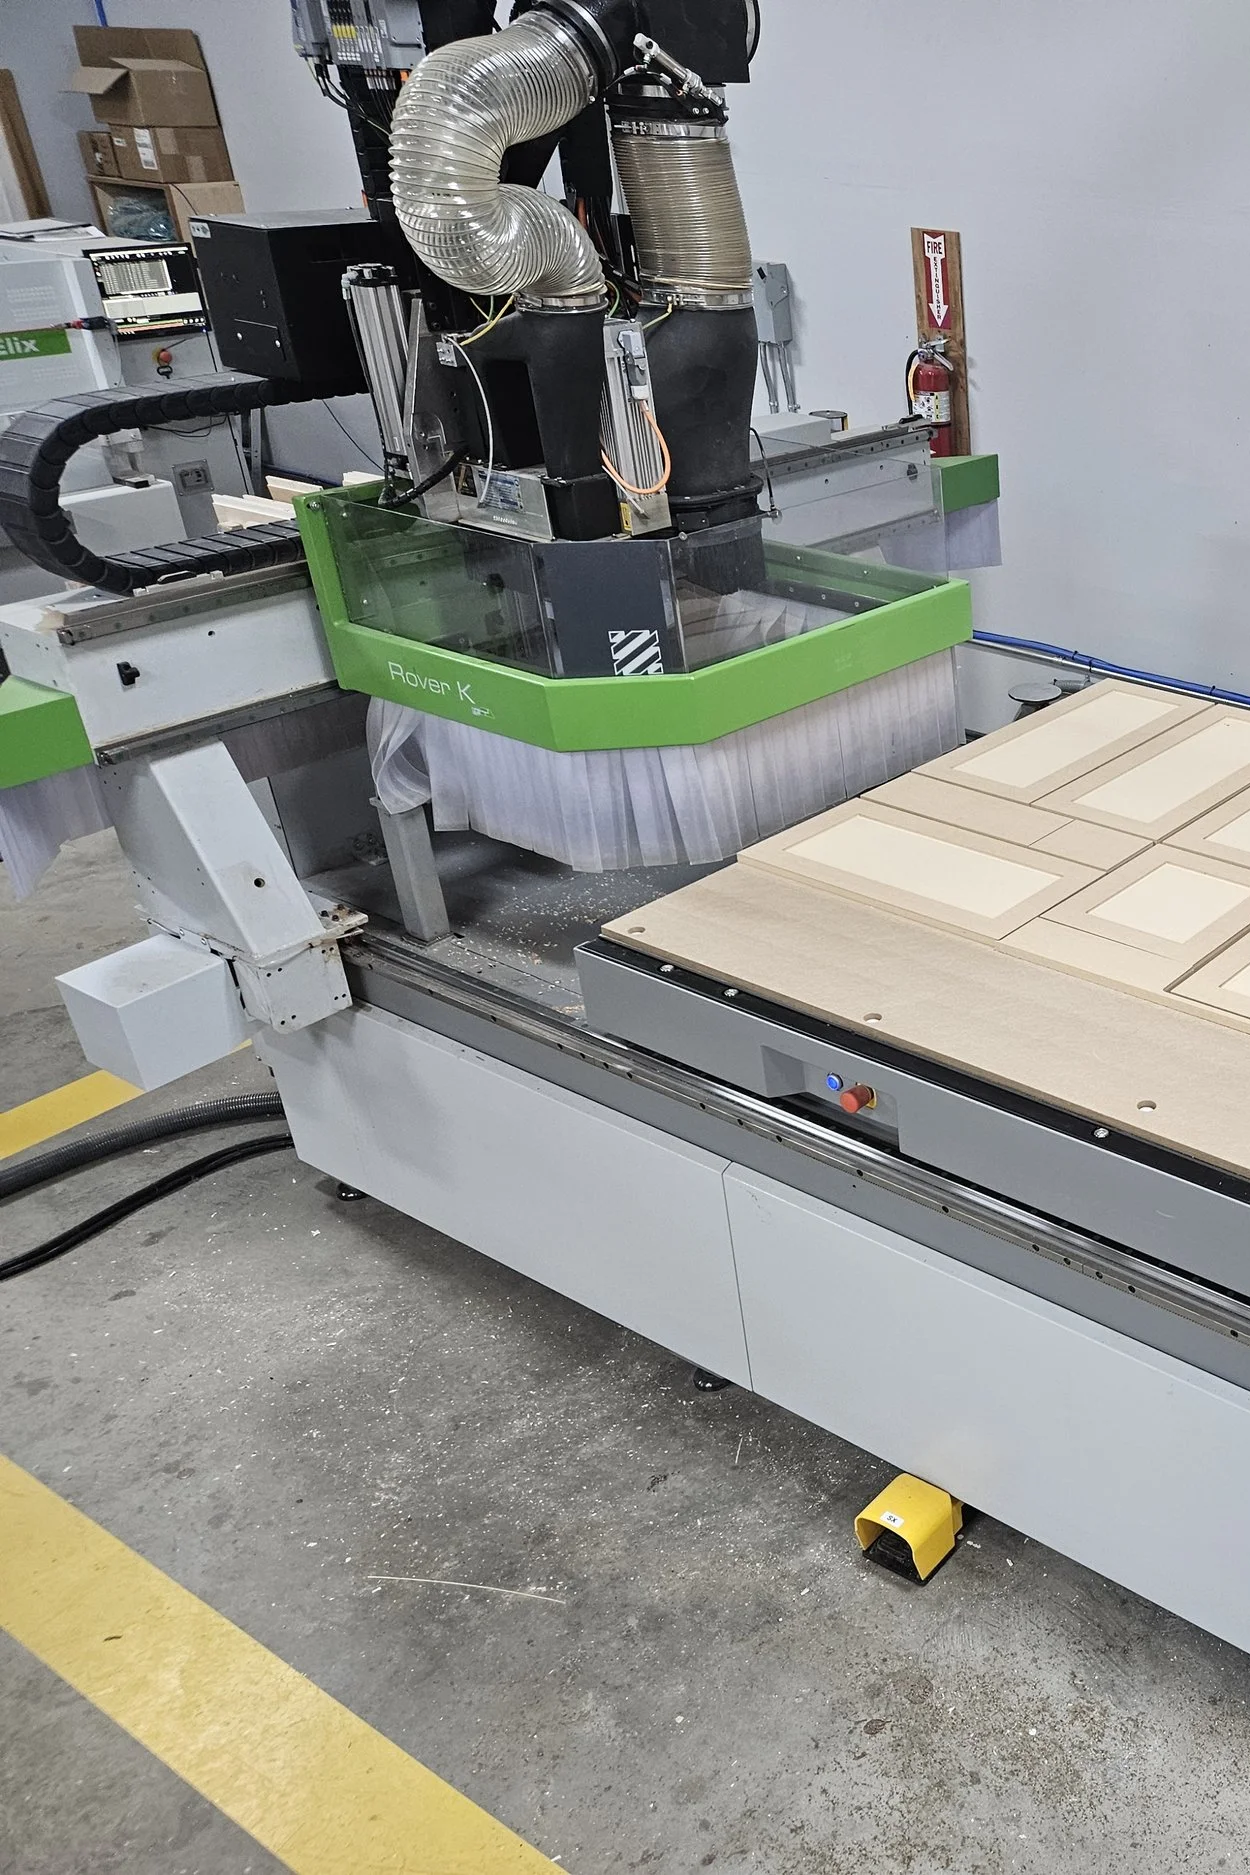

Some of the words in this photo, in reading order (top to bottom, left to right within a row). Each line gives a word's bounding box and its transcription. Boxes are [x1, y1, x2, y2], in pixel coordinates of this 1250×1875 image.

[926, 241, 943, 255] FIRE
[933, 256, 942, 320] EXTINGUISHER
[387, 661, 451, 696] Rover
[456, 681, 476, 705] K
[887, 1515, 898, 1523] SX
